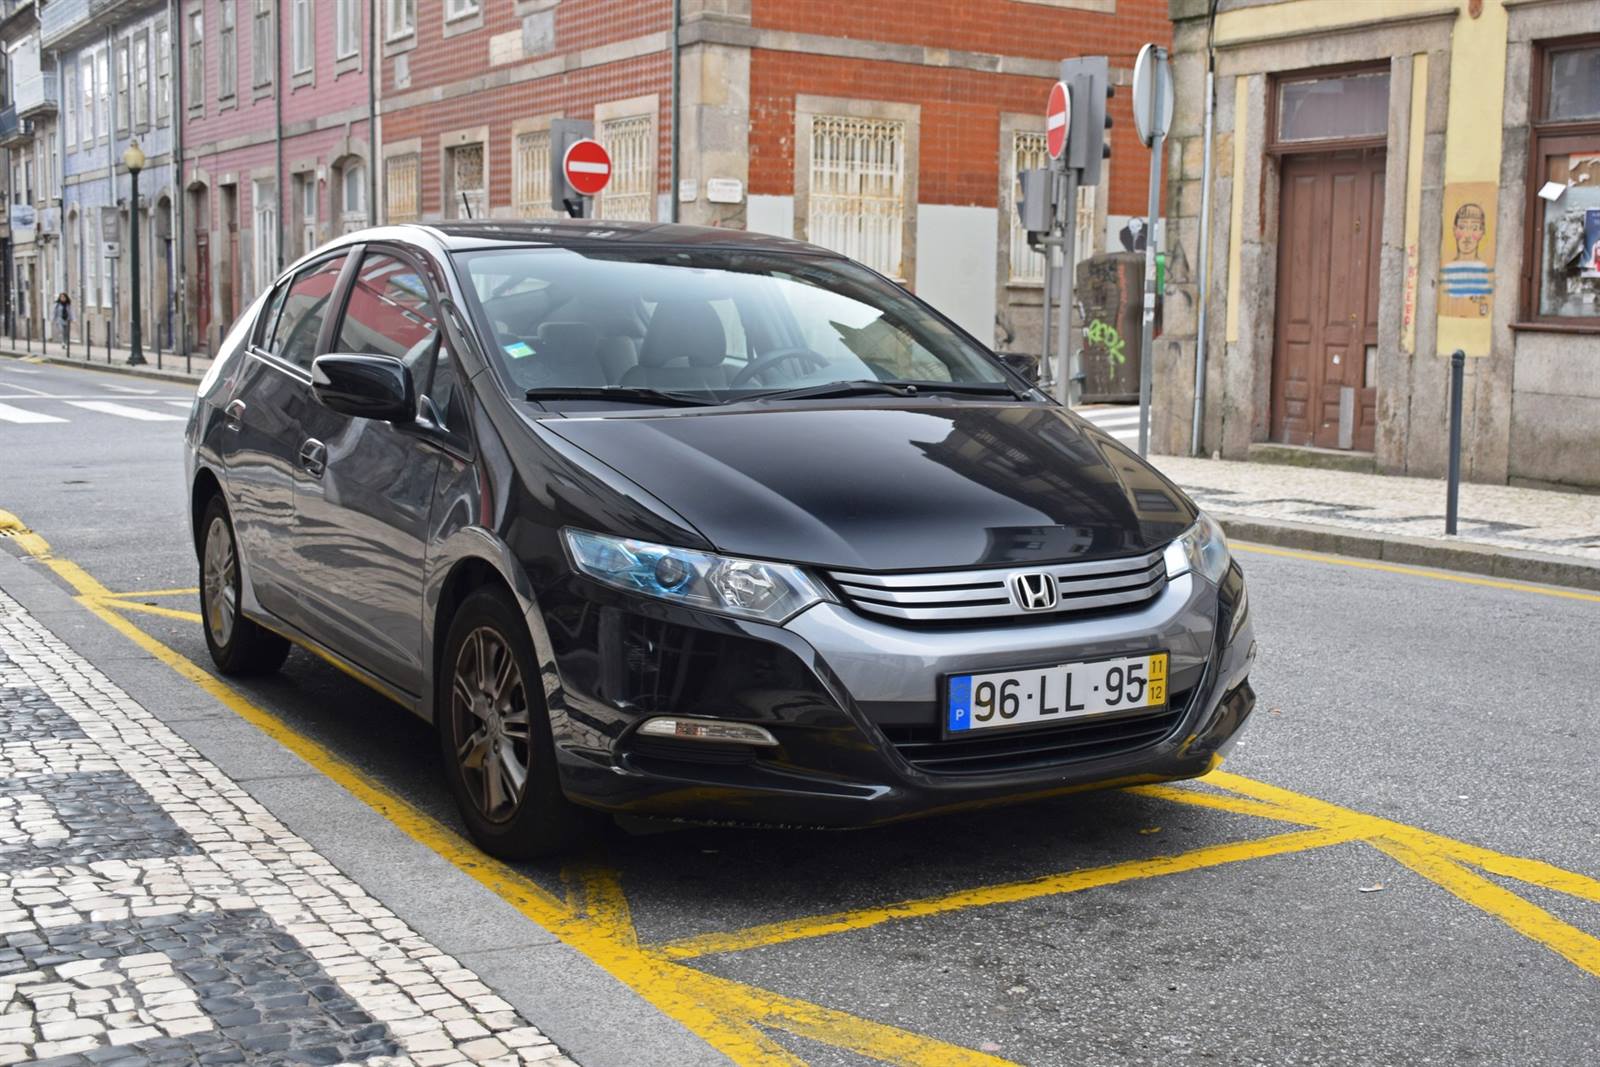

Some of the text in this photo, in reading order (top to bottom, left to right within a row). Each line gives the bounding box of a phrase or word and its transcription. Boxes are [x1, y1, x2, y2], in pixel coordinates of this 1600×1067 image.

[1152, 660, 1163, 674] 11
[1150, 686, 1162, 700] 12
[955, 709, 965, 721] P
